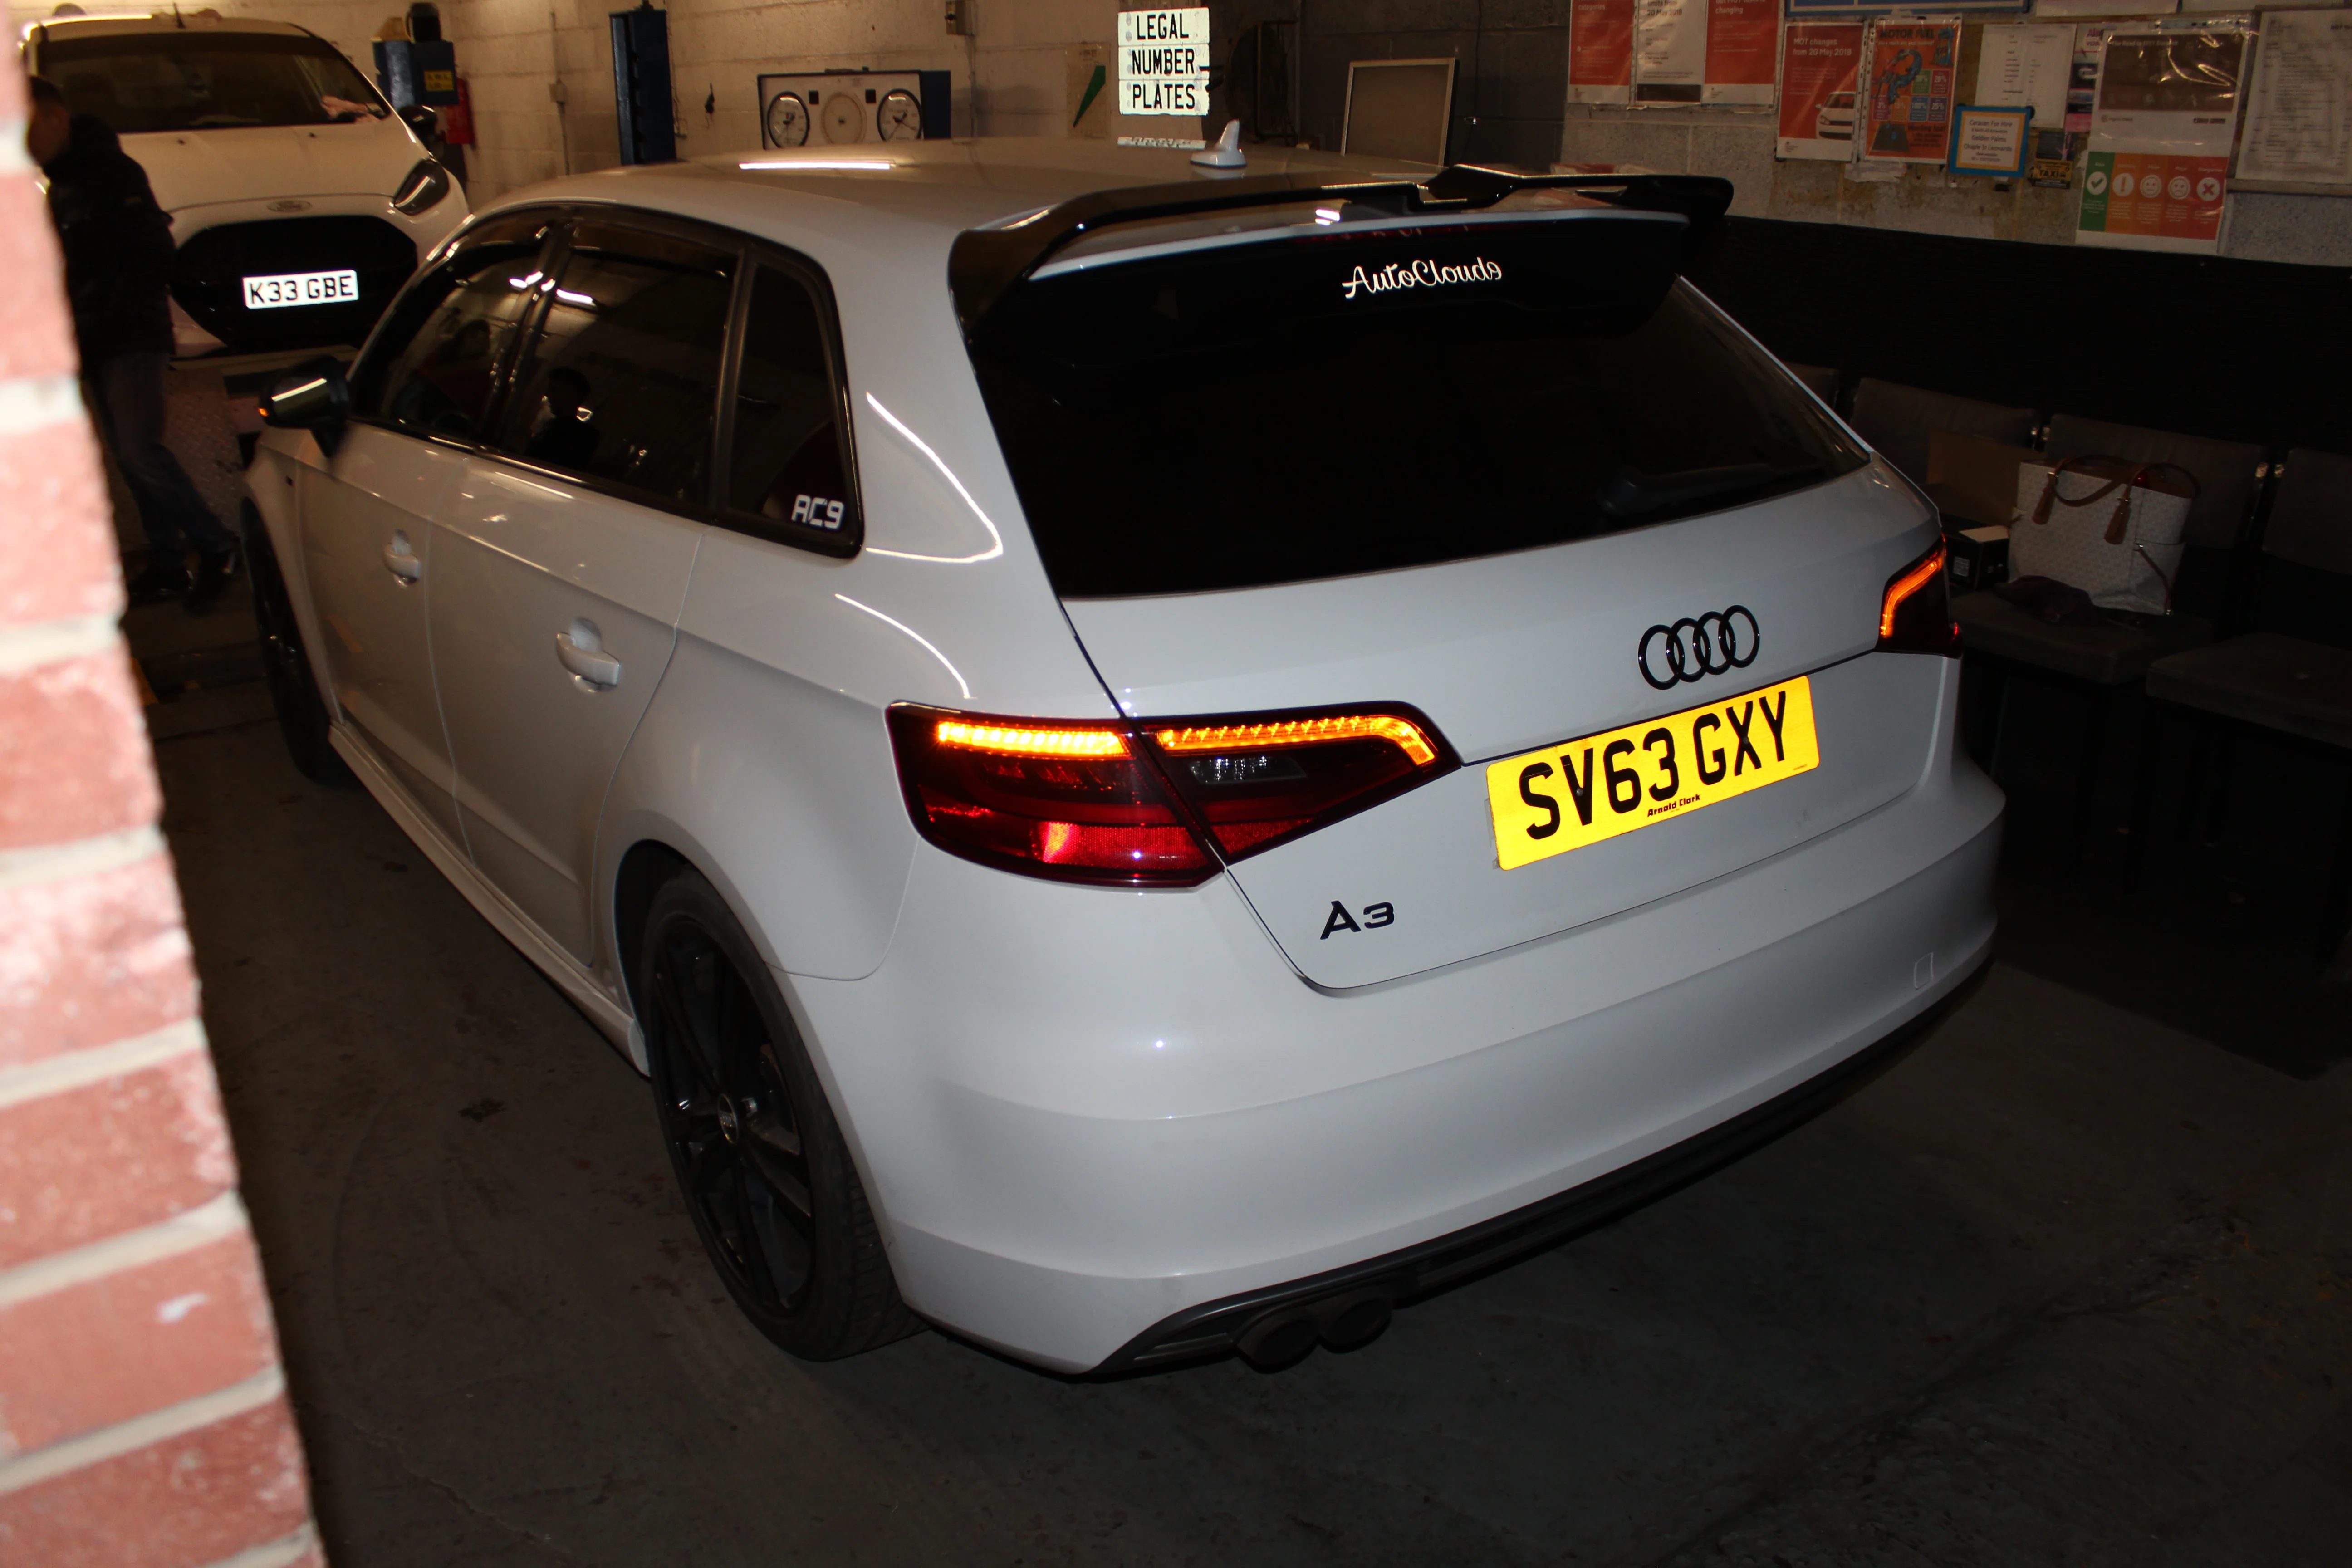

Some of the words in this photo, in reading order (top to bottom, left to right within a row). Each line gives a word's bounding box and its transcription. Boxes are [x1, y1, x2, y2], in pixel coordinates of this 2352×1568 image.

[1715, 6, 1744, 15] changing
[1137, 13, 1189, 40] LEGAL
[1880, 28, 1914, 40] MOTOR
[1915, 28, 1935, 39] FUEL
[1808, 47, 1818, 56] 20
[1819, 48, 1833, 58] May
[1809, 38, 1838, 47] changes
[1132, 48, 1195, 75] NUMBER
[1132, 83, 1196, 109] PLATES
[2039, 169, 2059, 178] TAXI
[250, 280, 298, 304] K33
[307, 275, 353, 299] GBE
[1342, 256, 1502, 299] AutoClouds
[791, 493, 845, 530] AC9
[1519, 727, 1680, 840] SV63
[1692, 690, 1787, 786] GXY
[1647, 800, 1677, 818] Arnold
[1679, 793, 1701, 807] Clark
[1320, 900, 1395, 940] A3
